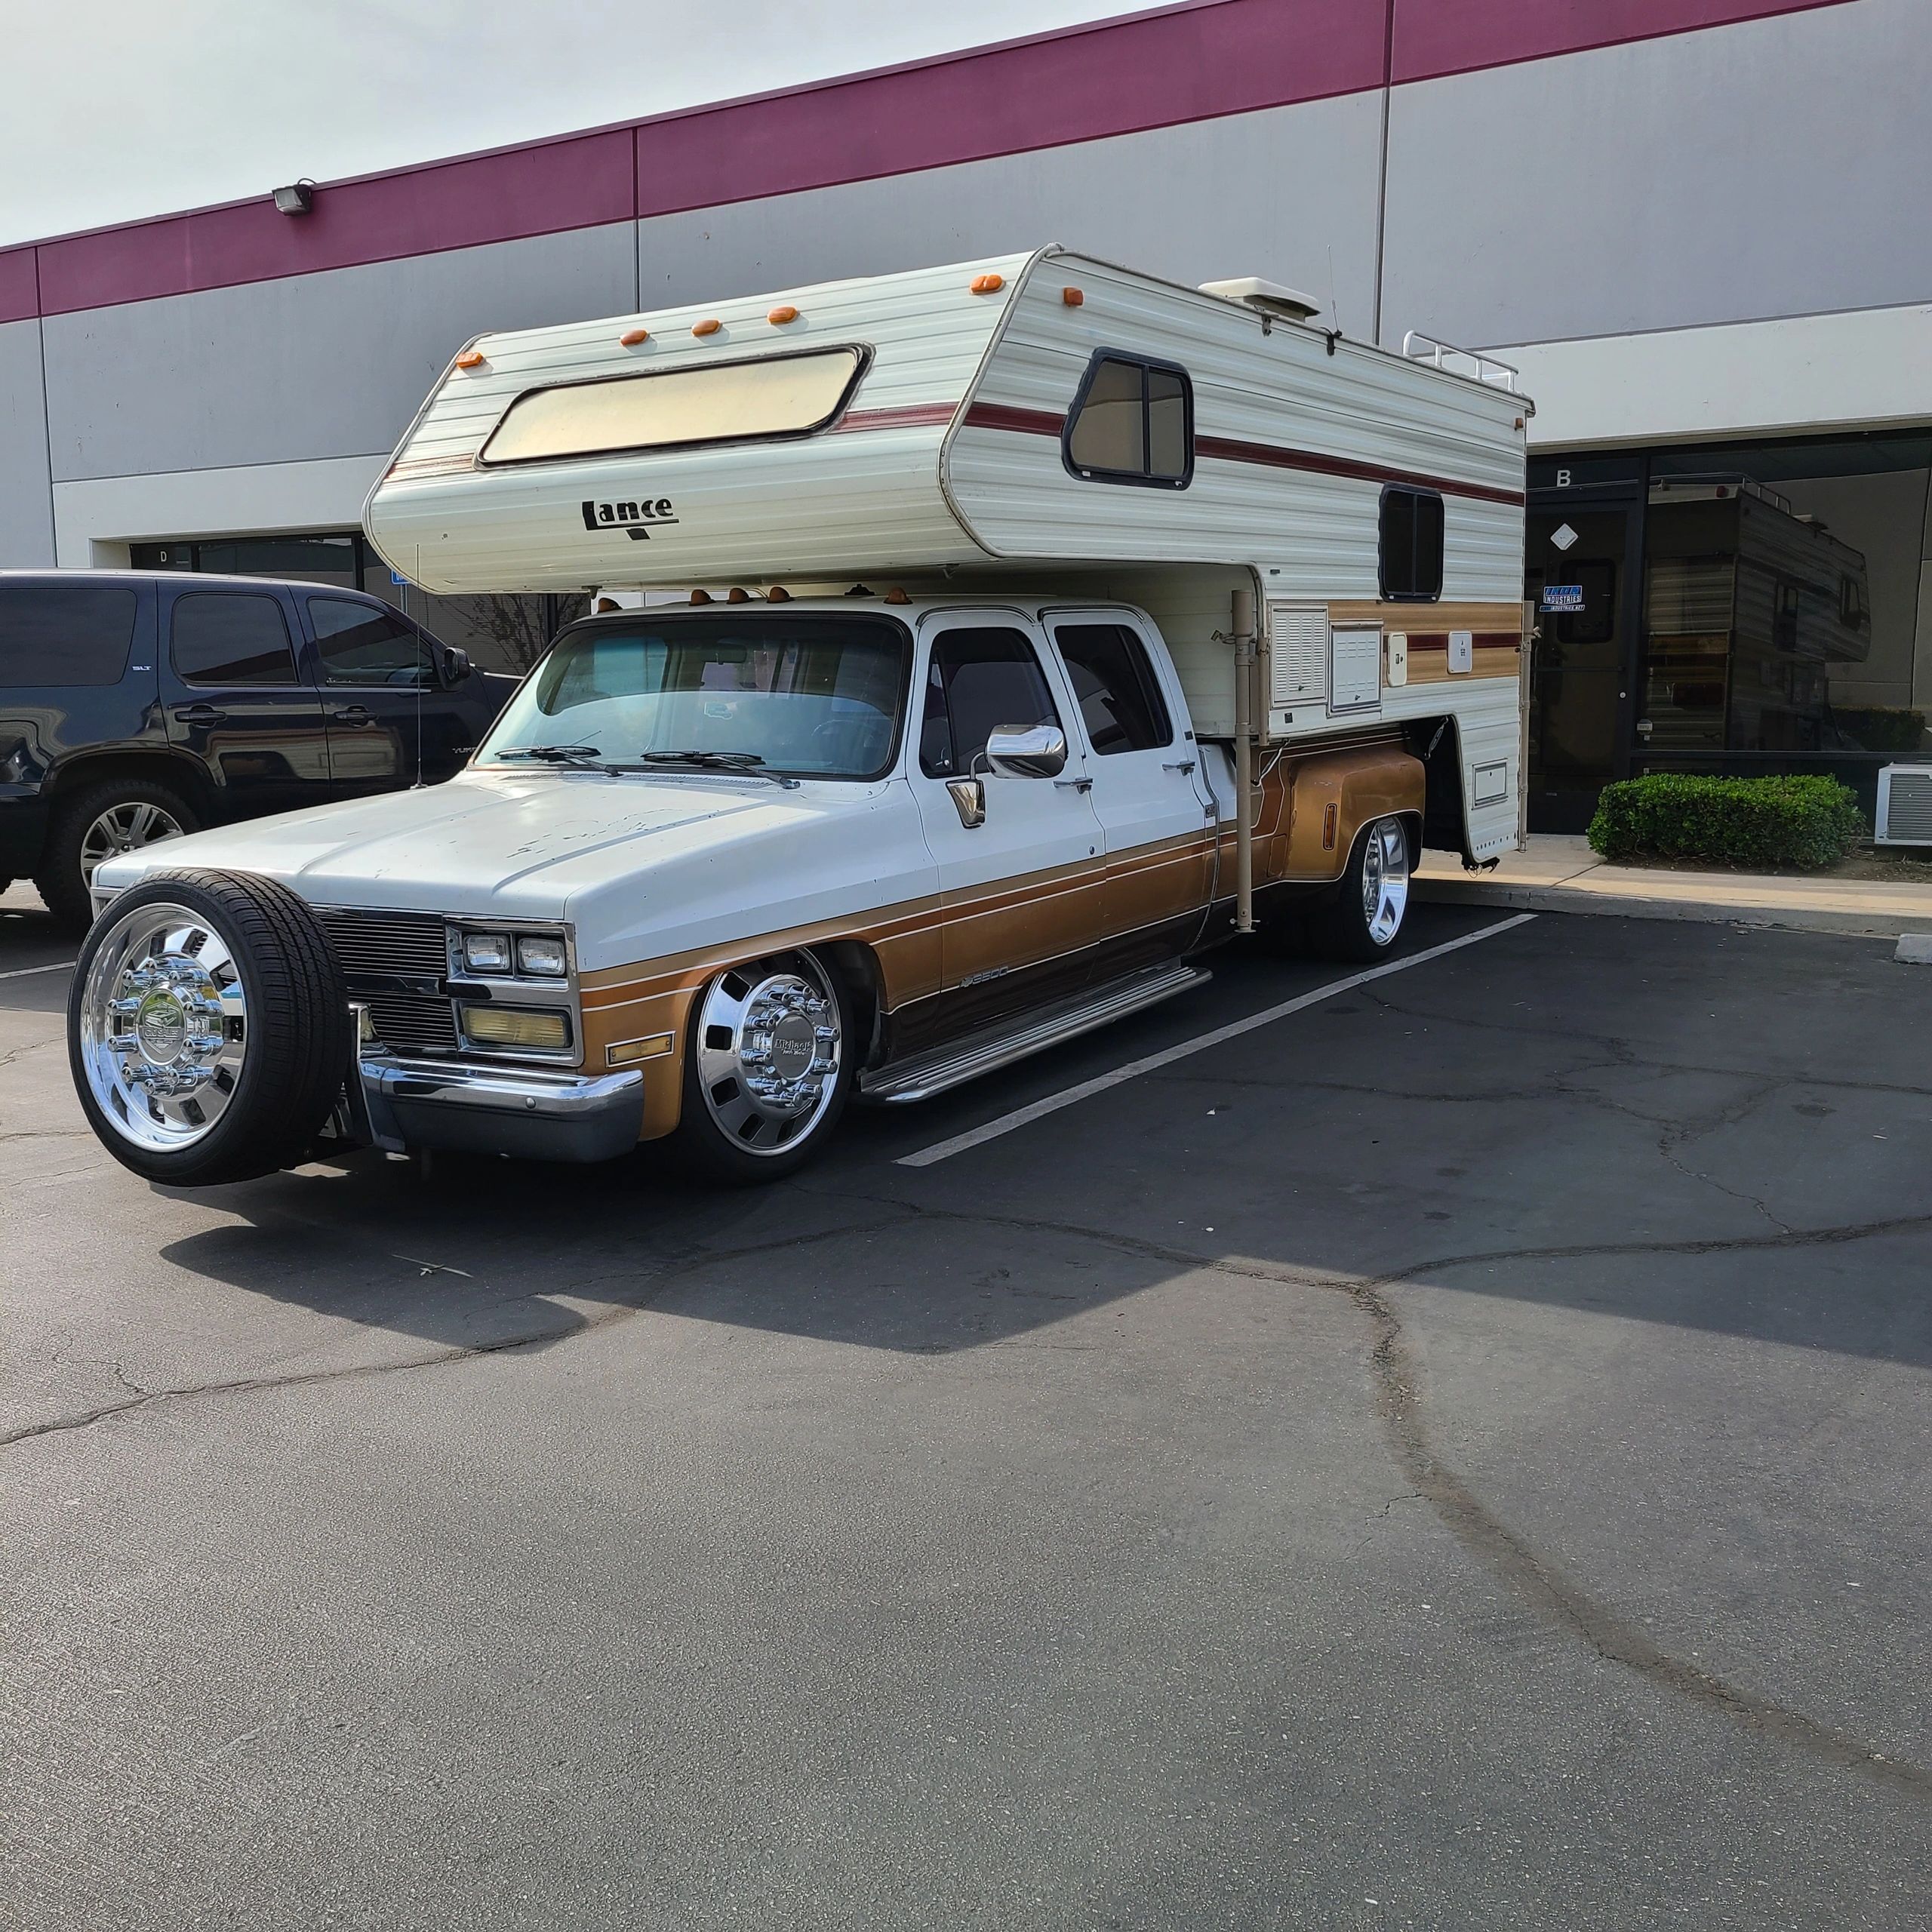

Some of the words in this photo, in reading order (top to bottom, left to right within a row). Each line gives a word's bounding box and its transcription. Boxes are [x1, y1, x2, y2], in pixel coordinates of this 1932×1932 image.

[1556, 469, 1571, 488] B
[582, 497, 680, 531] Lance
[161, 551, 168, 562] D
[1544, 595, 1581, 604] INDUSTRIES
